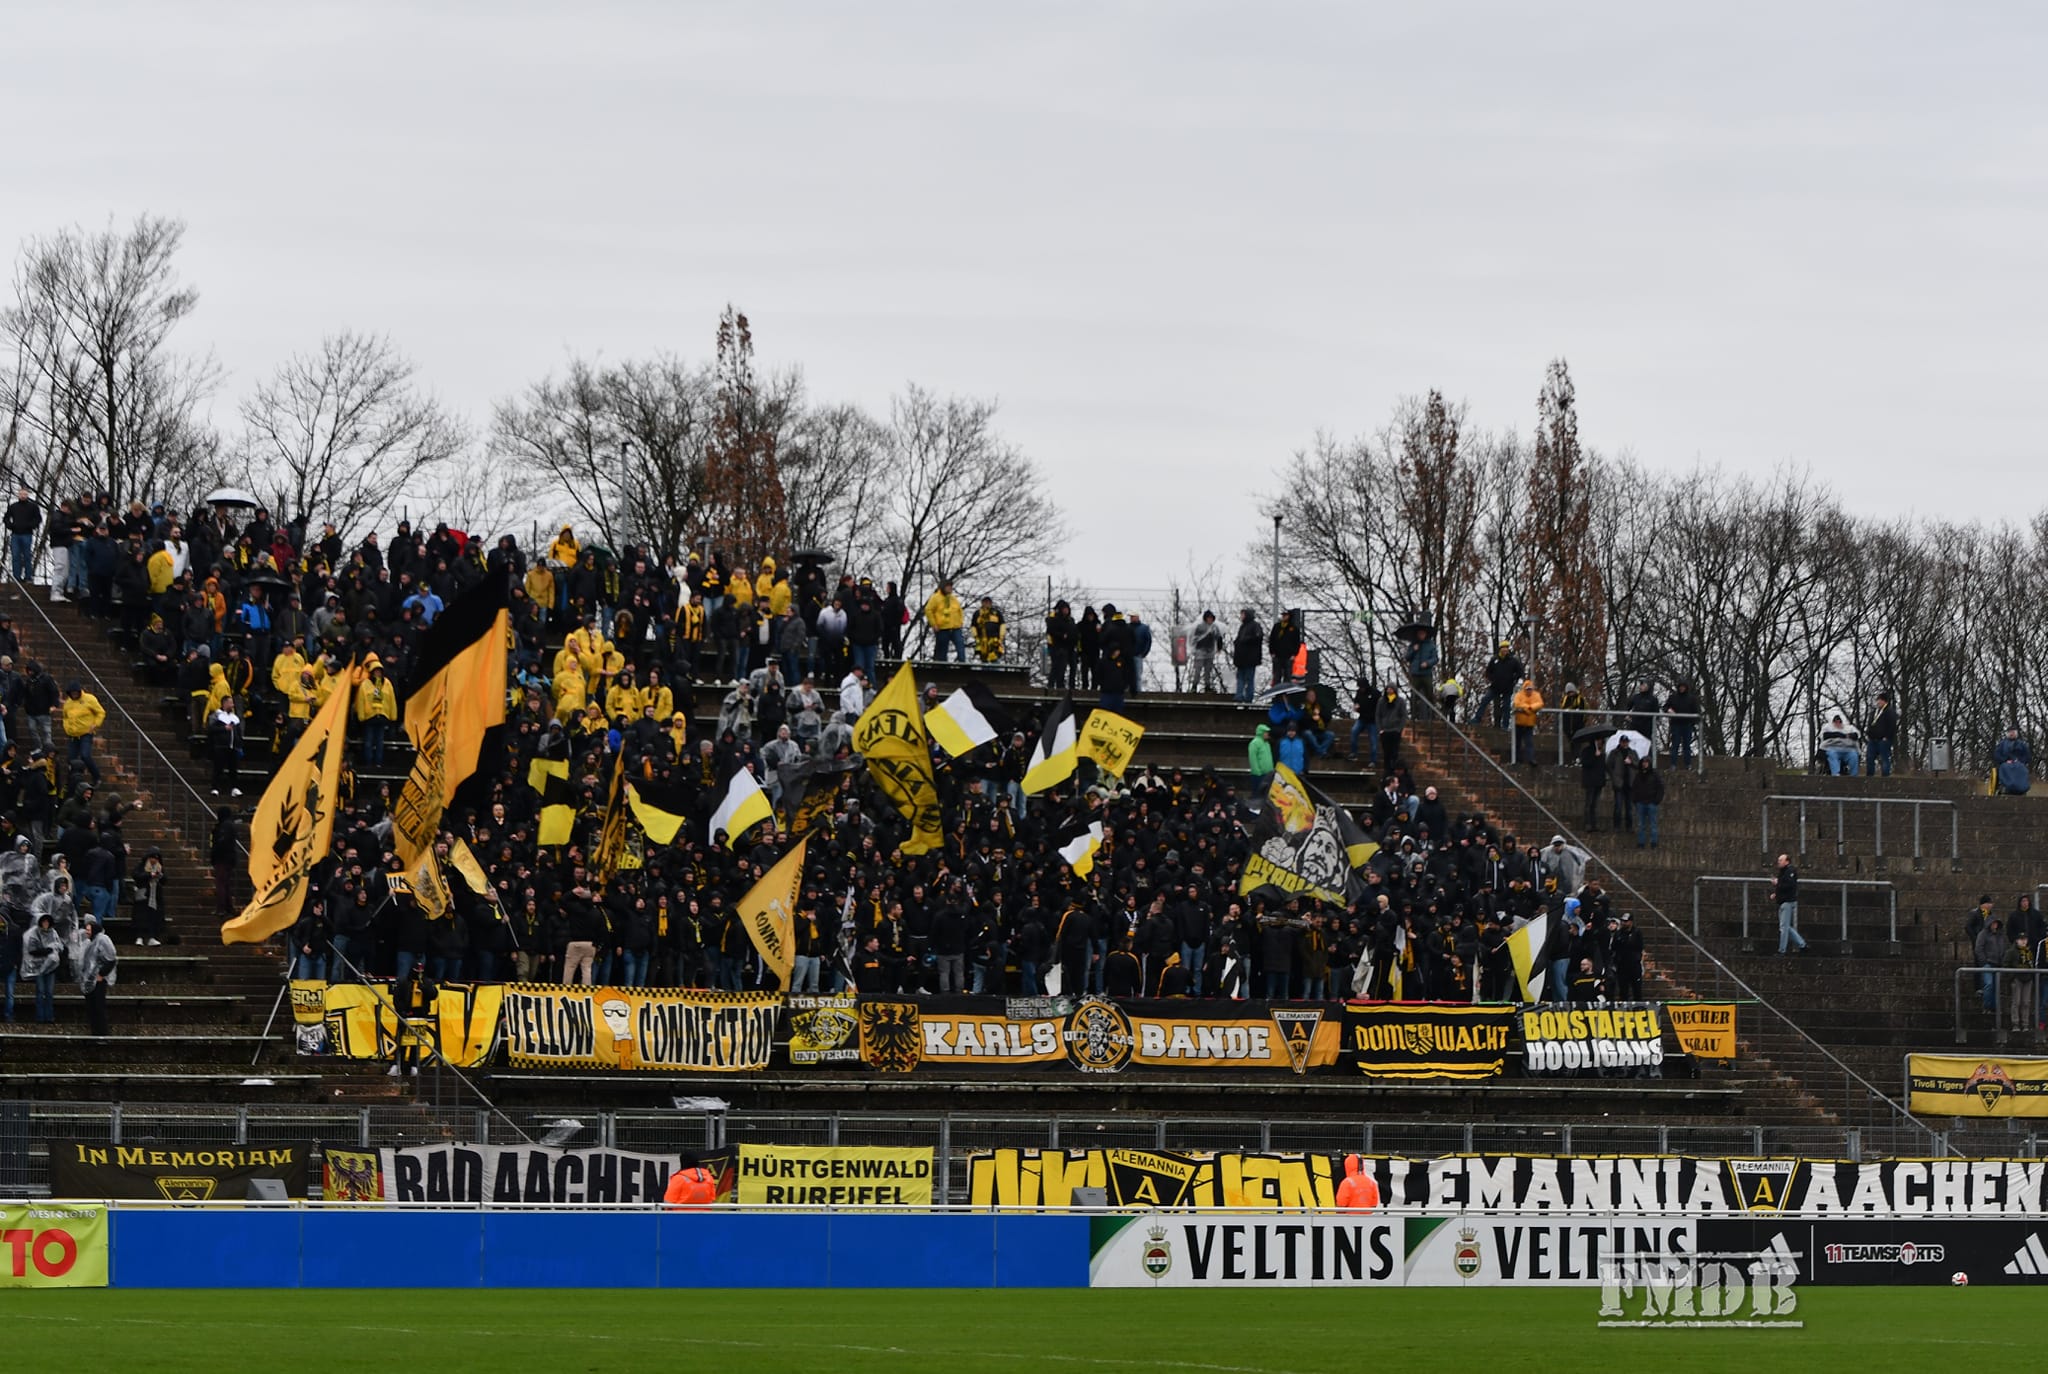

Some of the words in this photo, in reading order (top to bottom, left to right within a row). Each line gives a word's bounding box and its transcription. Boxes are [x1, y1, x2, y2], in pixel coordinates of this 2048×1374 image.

[818, 997, 858, 1008] STADT
[1672, 1010, 1730, 1025] OECHER
[507, 994, 594, 1056] YELLOW
[638, 1002, 781, 1067] CONNECTION
[922, 1022, 1058, 1056] KARLS
[1140, 1023, 1272, 1059] BANDE
[1355, 1024, 1407, 1051] DOM
[1434, 1024, 1510, 1051] WACHT
[1523, 1010, 1662, 1040] BOXSTAFFEL
[1526, 1038, 1664, 1071] HOOLIGANS
[1913, 1079, 1936, 1088] Tivoli
[1938, 1080, 1964, 1091] Tigers
[2016, 1083, 2040, 1092] Since
[394, 1147, 484, 1208] BAD
[494, 1149, 669, 1208] AACHEN
[742, 1154, 930, 1179] HÜRTGENWALD
[1112, 1150, 1187, 1177] ALEMANNIA
[1735, 1162, 1791, 1172] ALEMANNIA
[766, 1185, 909, 1205] RUREIFEL
[1372, 1156, 1732, 1214] LEMANNIA
[1800, 1161, 2046, 1214] AACHEN
[0, 1229, 77, 1278] TO
[1184, 1225, 1394, 1280] VELTINS
[1492, 1226, 1690, 1280] VELTINS
